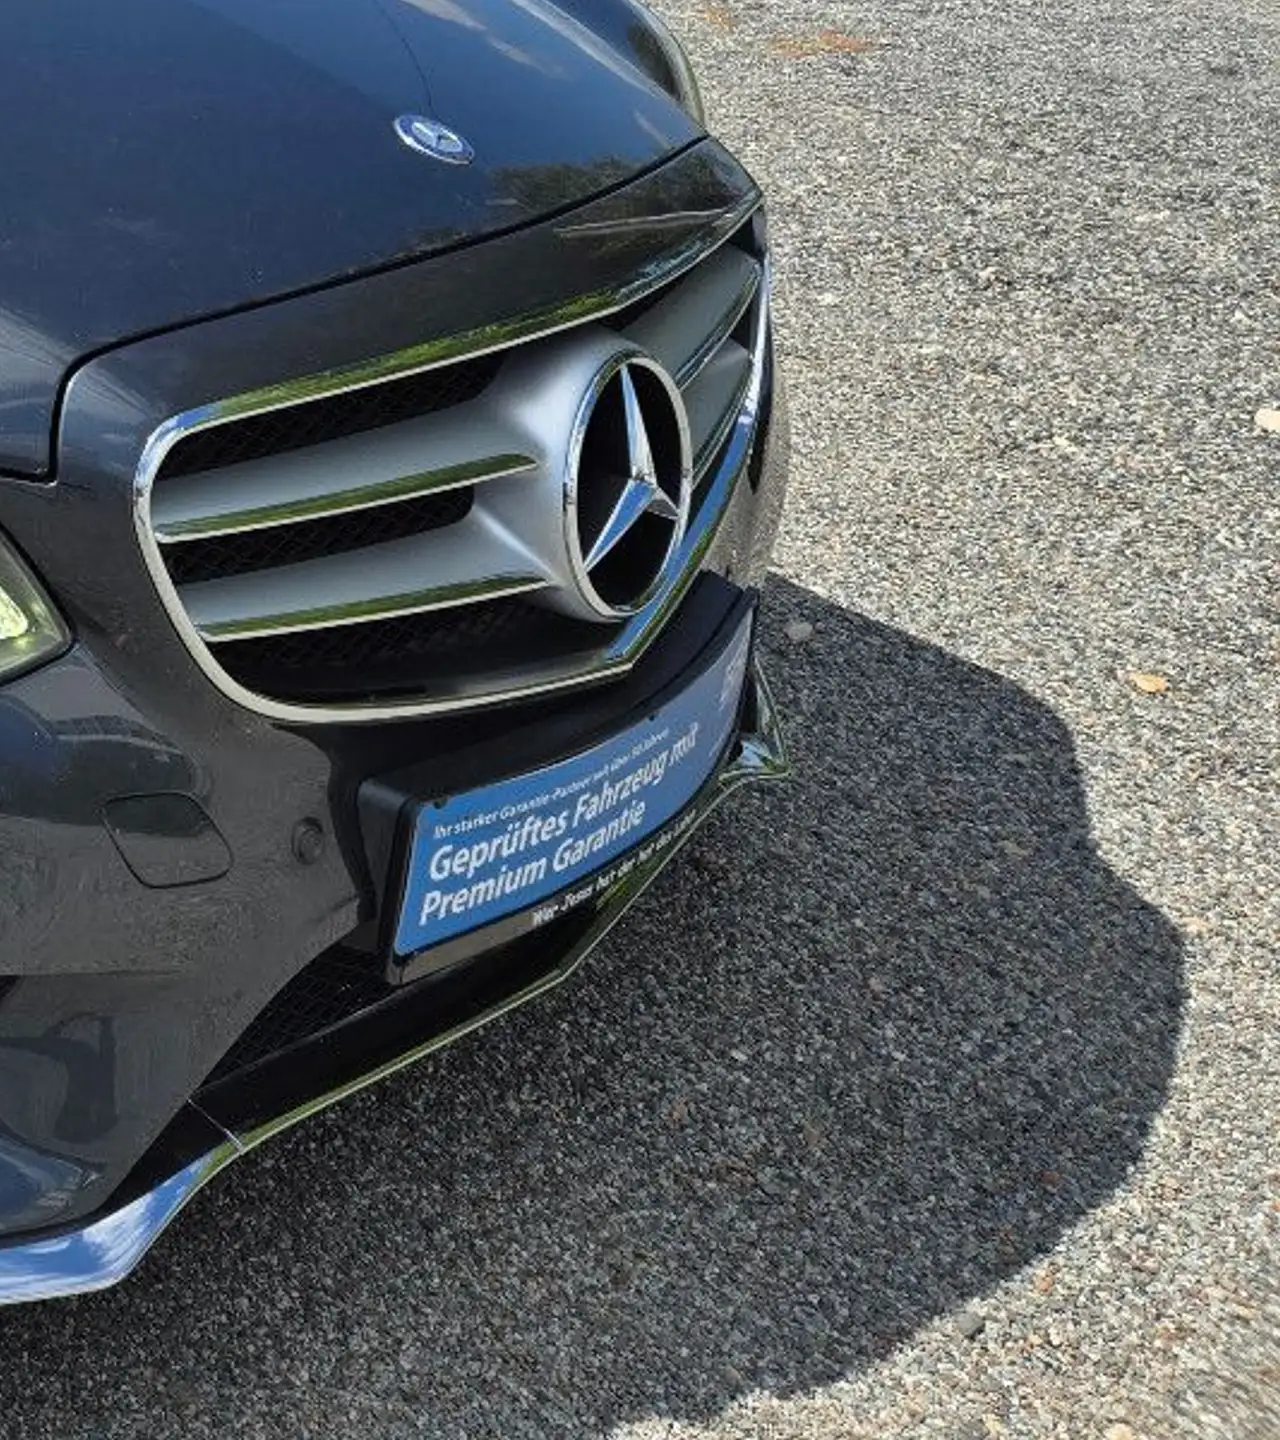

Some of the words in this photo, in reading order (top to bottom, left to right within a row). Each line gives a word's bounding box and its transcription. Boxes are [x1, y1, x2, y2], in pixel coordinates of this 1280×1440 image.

[419, 856, 547, 927] Premium
[552, 798, 646, 872] Garantie
[429, 809, 568, 881] Geprüftes
[572, 751, 668, 828] Fahrzeug
[668, 721, 699, 766] mit
